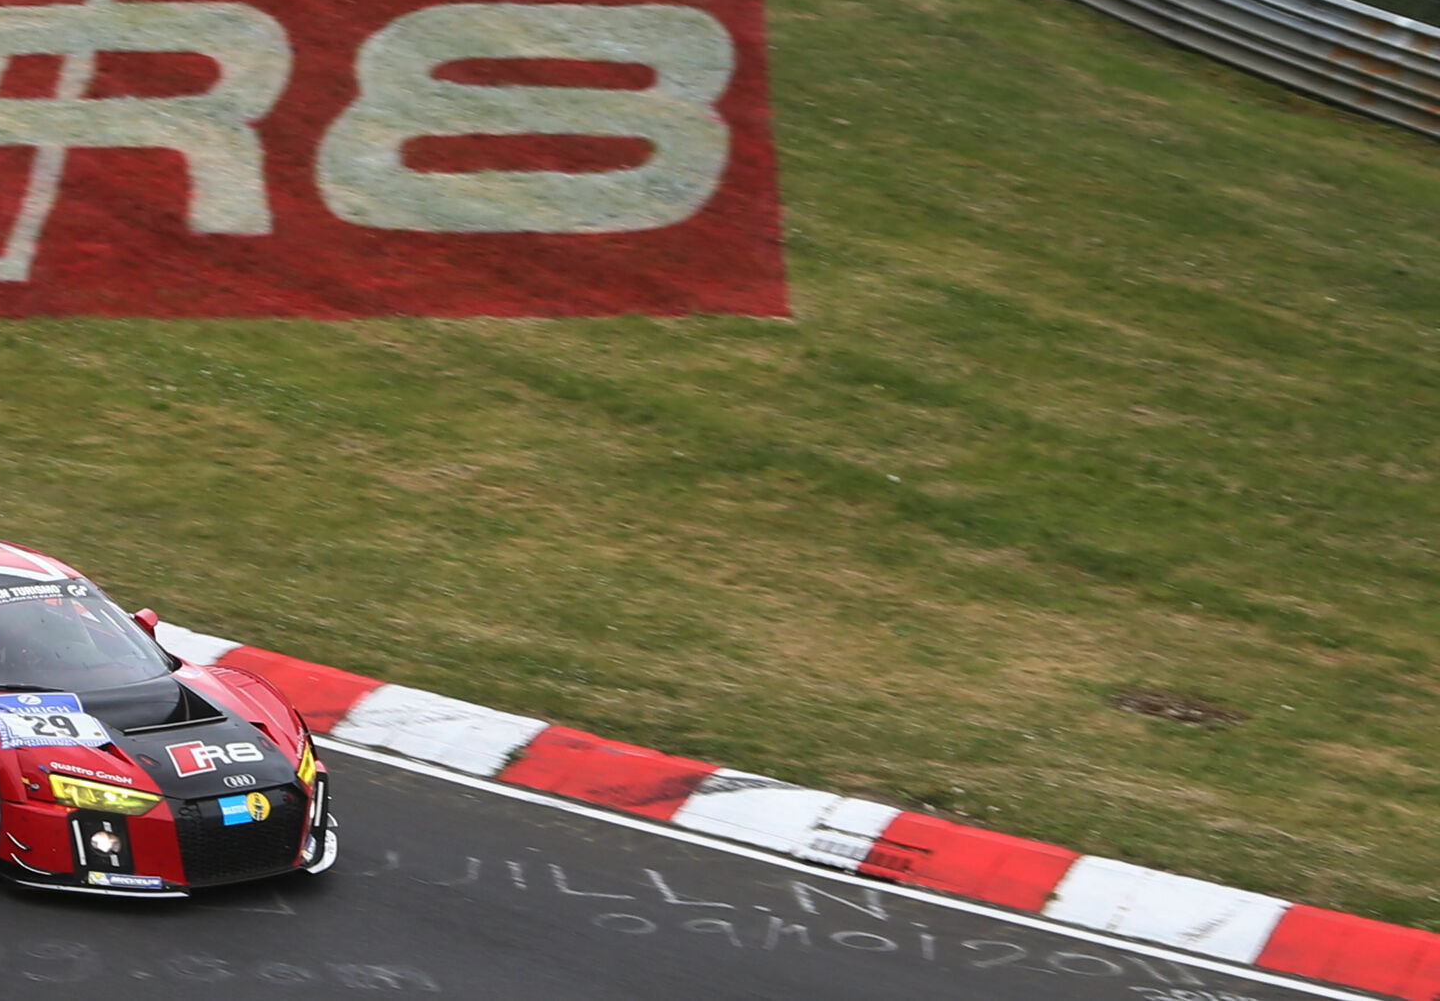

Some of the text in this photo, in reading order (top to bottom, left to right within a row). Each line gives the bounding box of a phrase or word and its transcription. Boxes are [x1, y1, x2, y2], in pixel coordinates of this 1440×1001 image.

[9, 584, 62, 597] TURISMO
[24, 714, 80, 739] 29
[190, 741, 265, 769] R8
[49, 761, 133, 785] quattro GmbH
